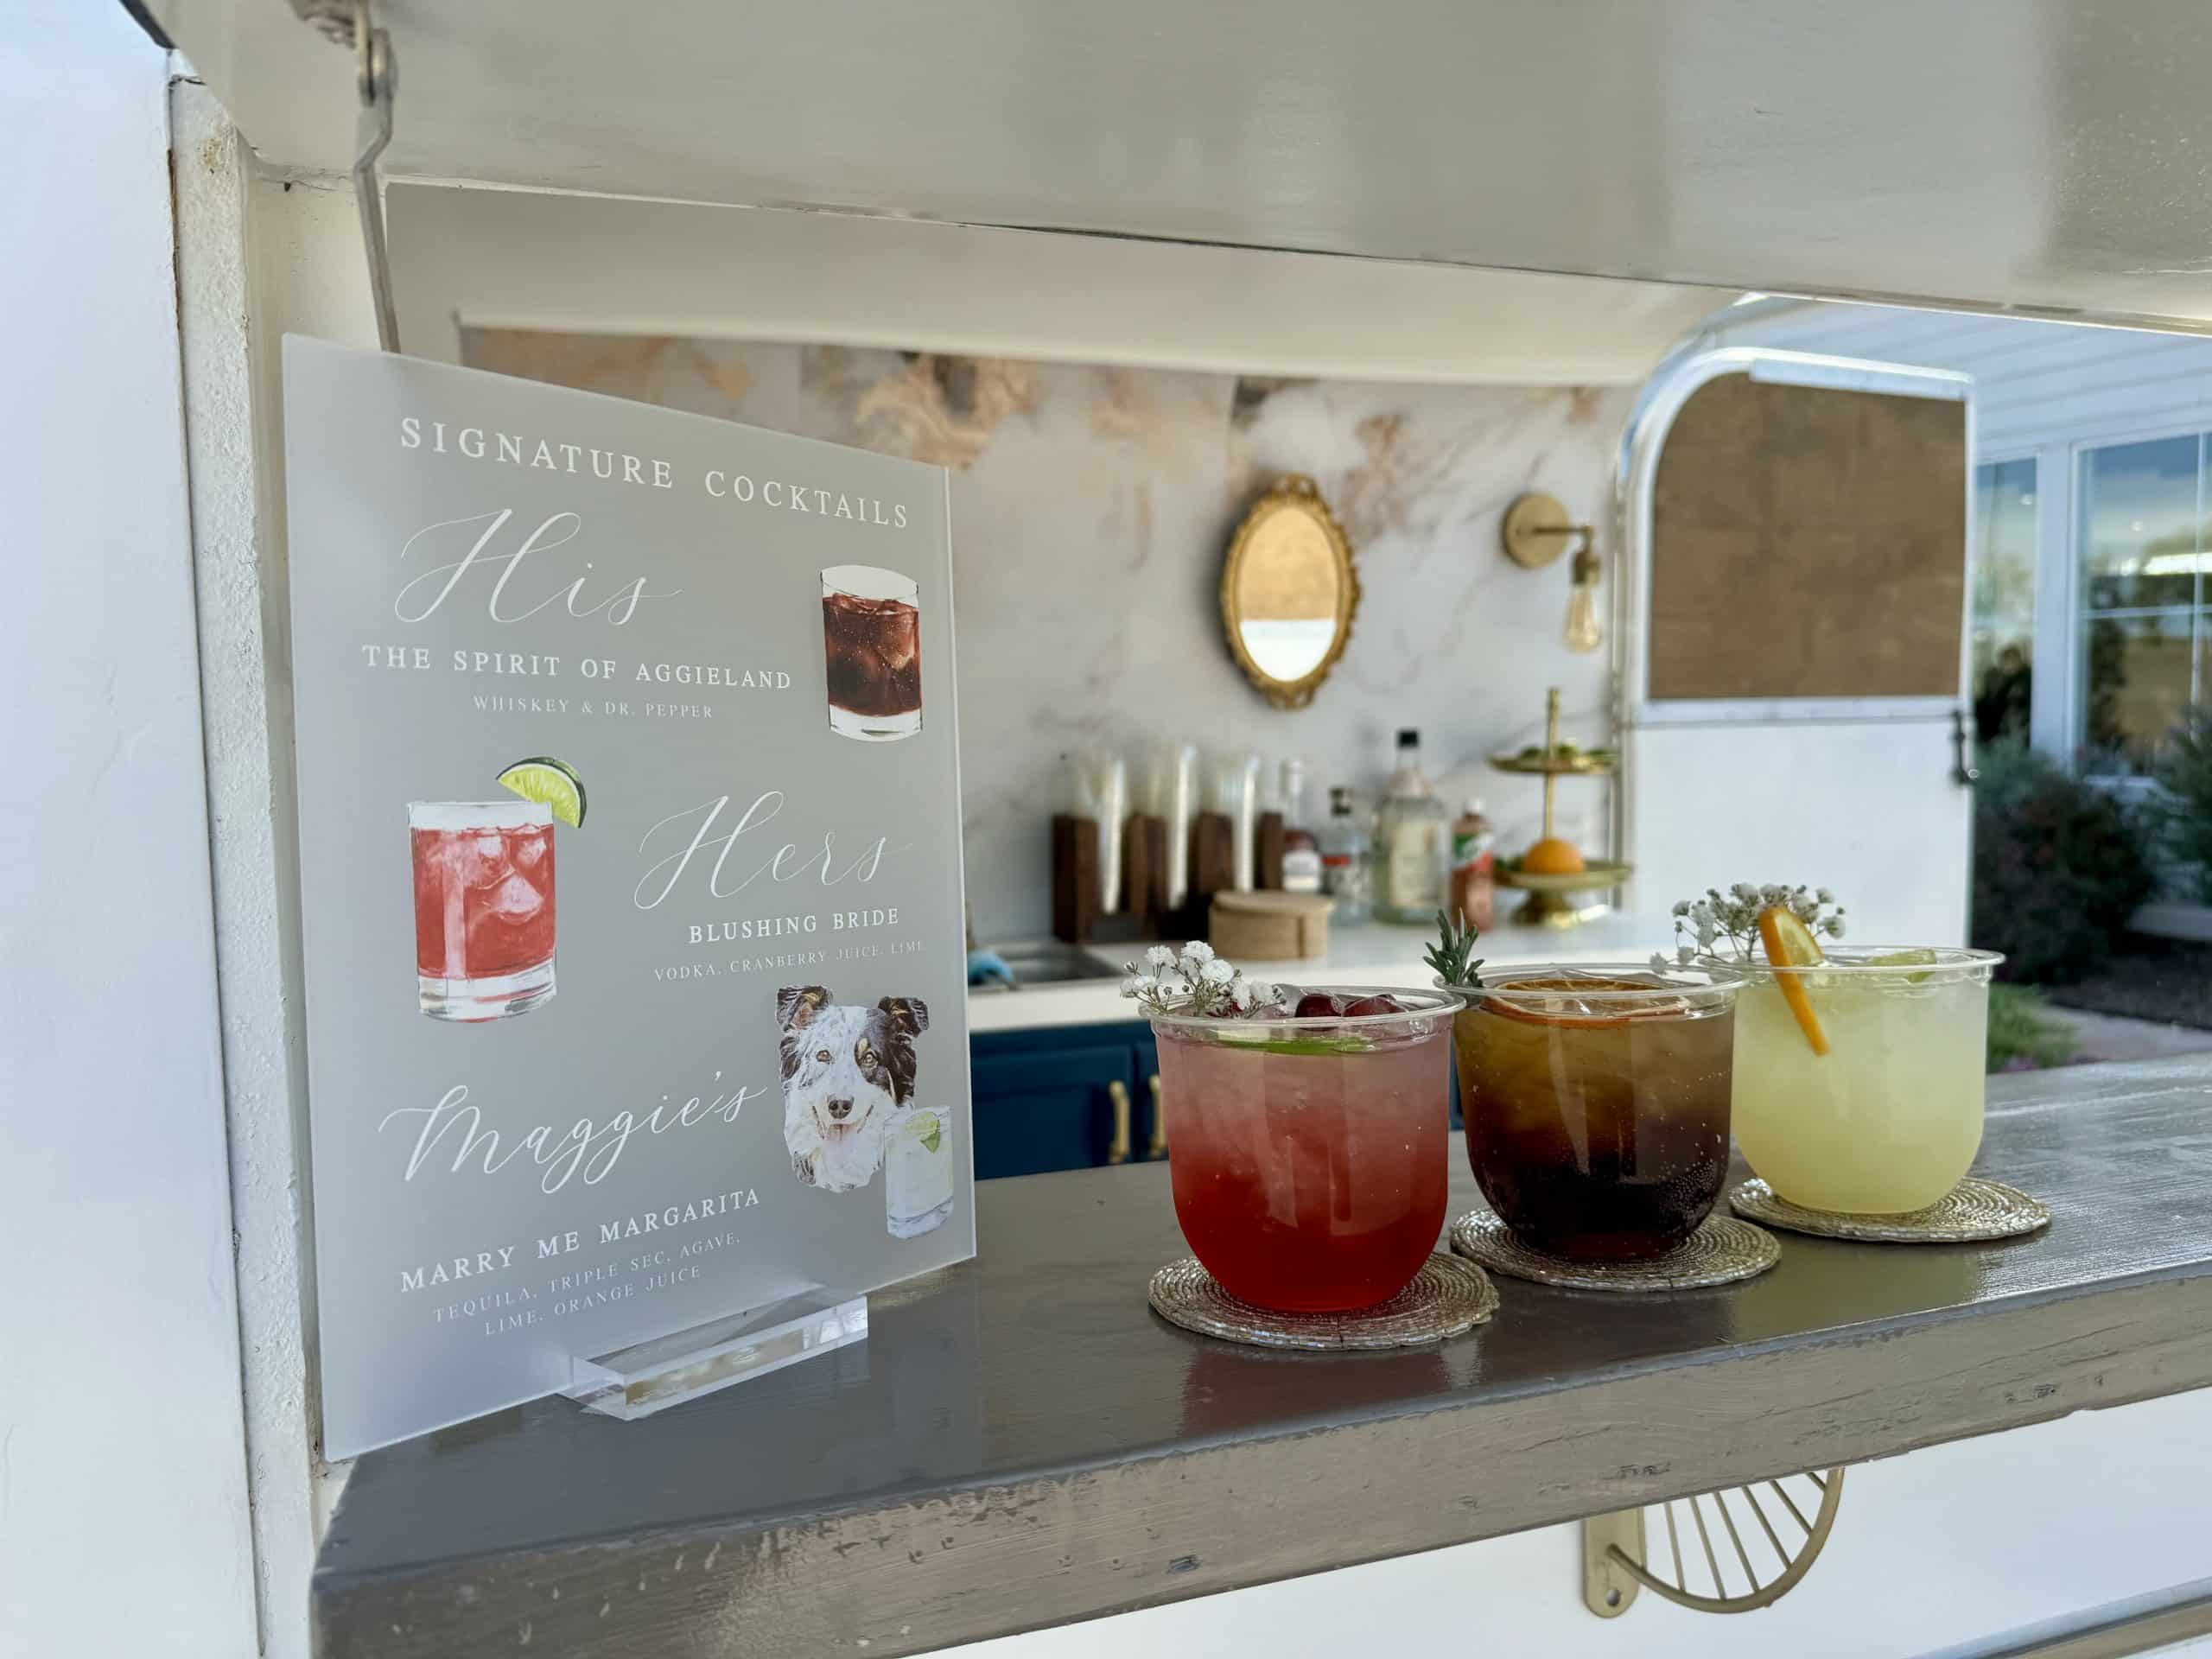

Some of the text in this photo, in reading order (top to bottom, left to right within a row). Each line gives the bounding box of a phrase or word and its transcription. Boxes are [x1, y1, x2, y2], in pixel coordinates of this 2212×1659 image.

[400, 417, 908, 527] SIGNATURE COCKTAILS
[395, 508, 683, 624] His
[362, 645, 791, 690] THE SPIRIT OF AGGIELAND
[474, 696, 713, 718] WHISKEY & DR. PEPPER
[634, 791, 912, 909] Hers
[690, 908, 899, 944] BLUSHING BRIDE
[730, 950, 825, 973] CRANBERRY
[378, 1071, 767, 1194] Maggie's
[401, 1188, 760, 1293] MARRY ME MARGARITA
[548, 1264, 619, 1294] TRIPLE
[680, 1231, 741, 1259] AGAVE,
[554, 1284, 634, 1315] ORANGE
[645, 1265, 700, 1291] JUICE
